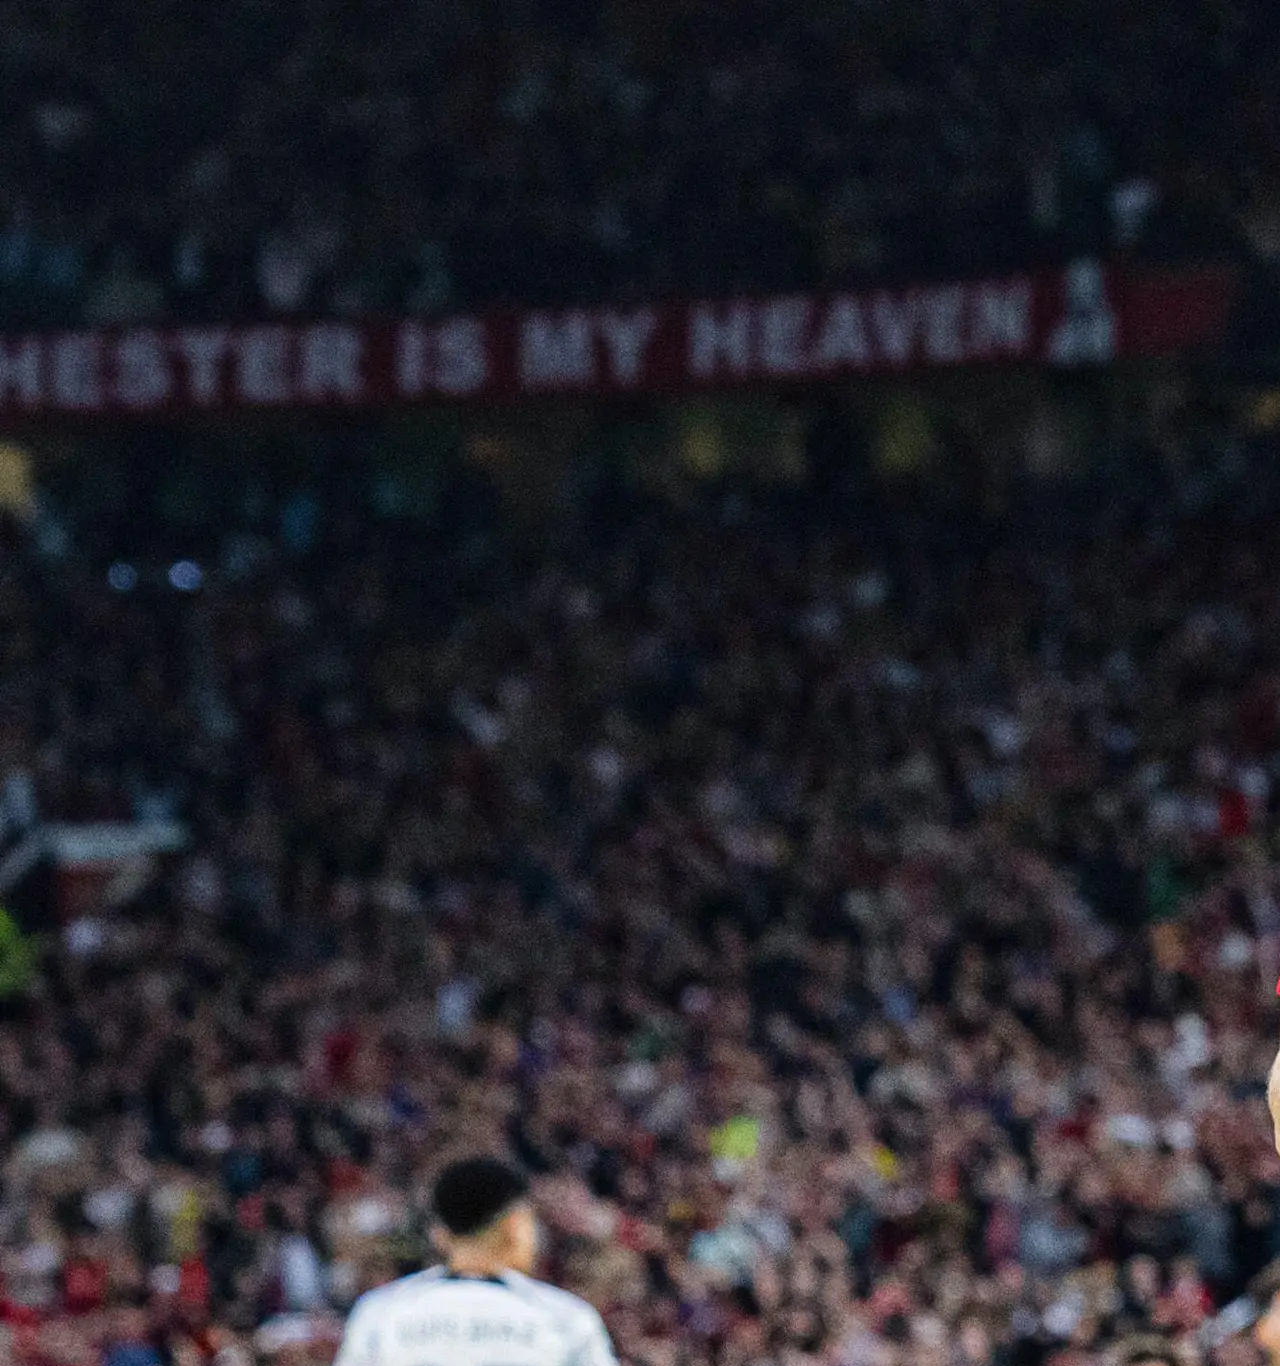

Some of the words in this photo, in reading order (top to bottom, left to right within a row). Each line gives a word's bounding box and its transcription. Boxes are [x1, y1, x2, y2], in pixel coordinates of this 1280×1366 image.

[0, 329, 362, 402] HESTER
[396, 318, 490, 394] IS
[518, 308, 654, 388] MY
[690, 281, 1032, 373] HEAVEN
